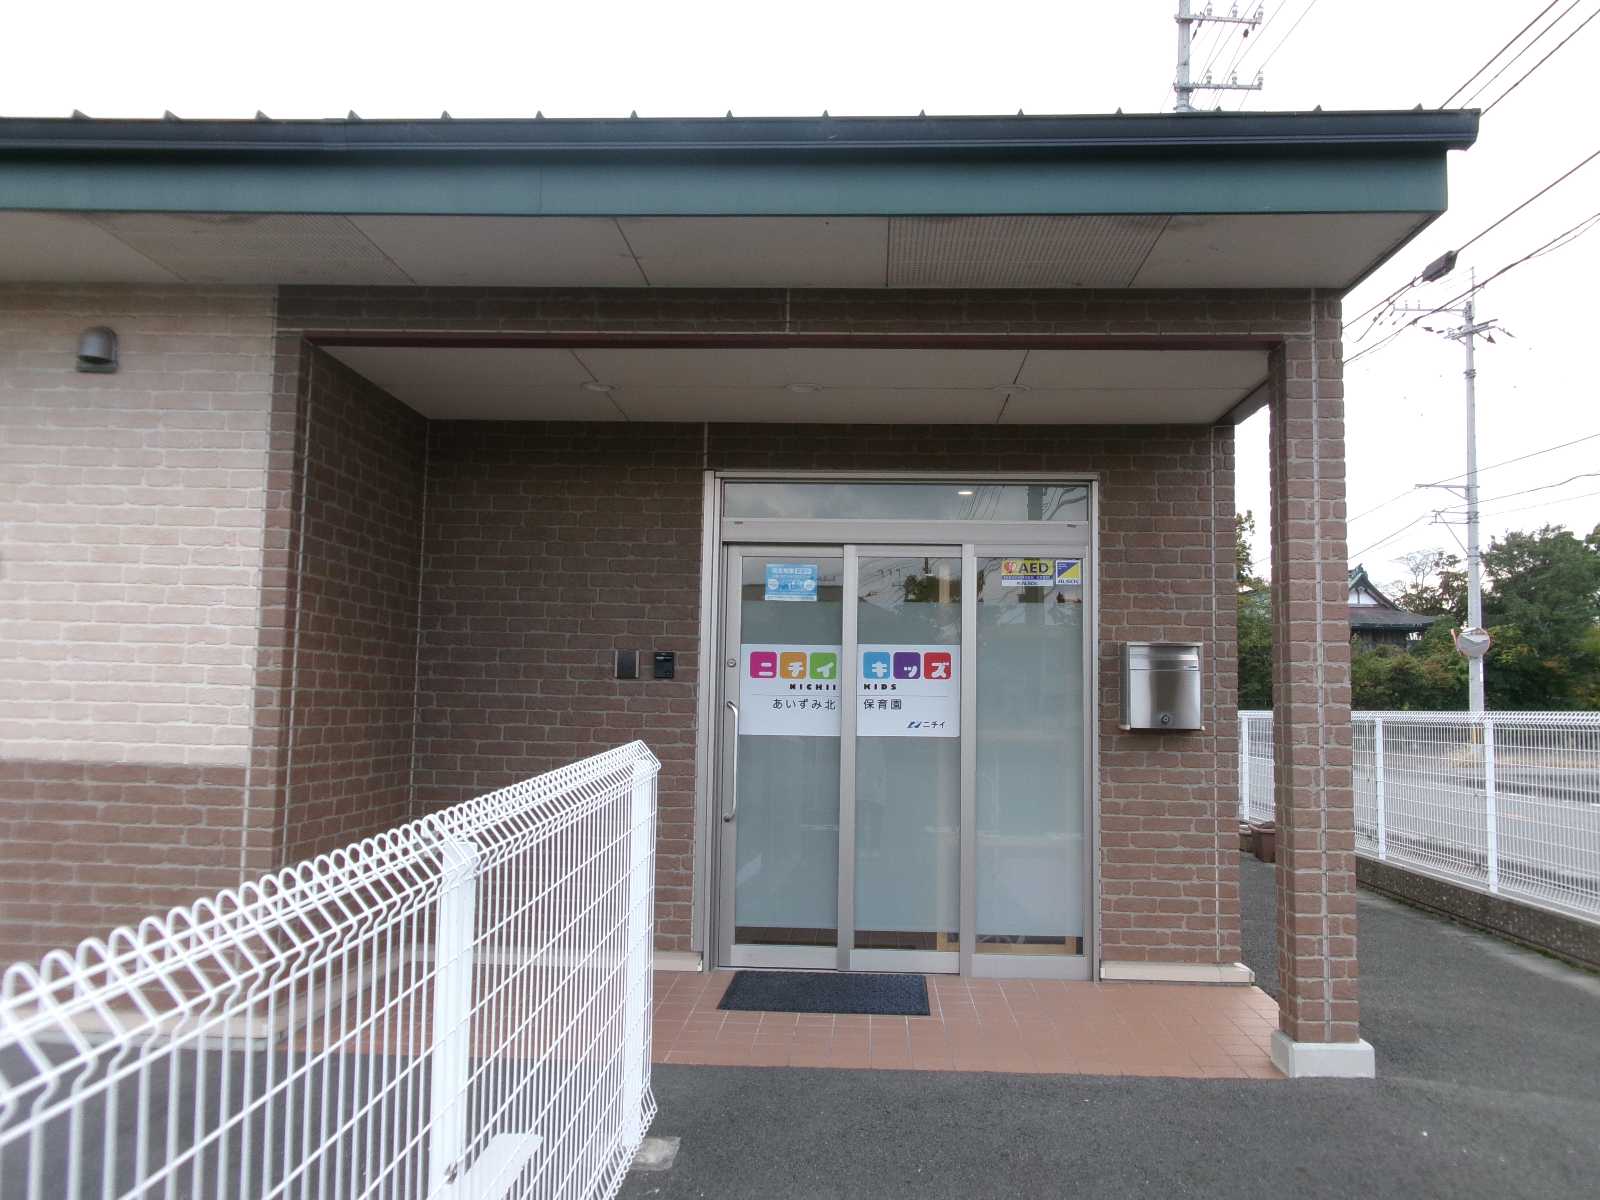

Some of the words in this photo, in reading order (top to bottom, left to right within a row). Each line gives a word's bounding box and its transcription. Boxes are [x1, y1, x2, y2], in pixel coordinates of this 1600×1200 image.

[1019, 562, 1049, 574] AED
[757, 659, 835, 678] ニチイ
[869, 659, 950, 679] キッズ
[772, 698, 836, 710] あいずみ北
[863, 698, 902, 710] 保育園
[922, 720, 945, 729] ニチイ
